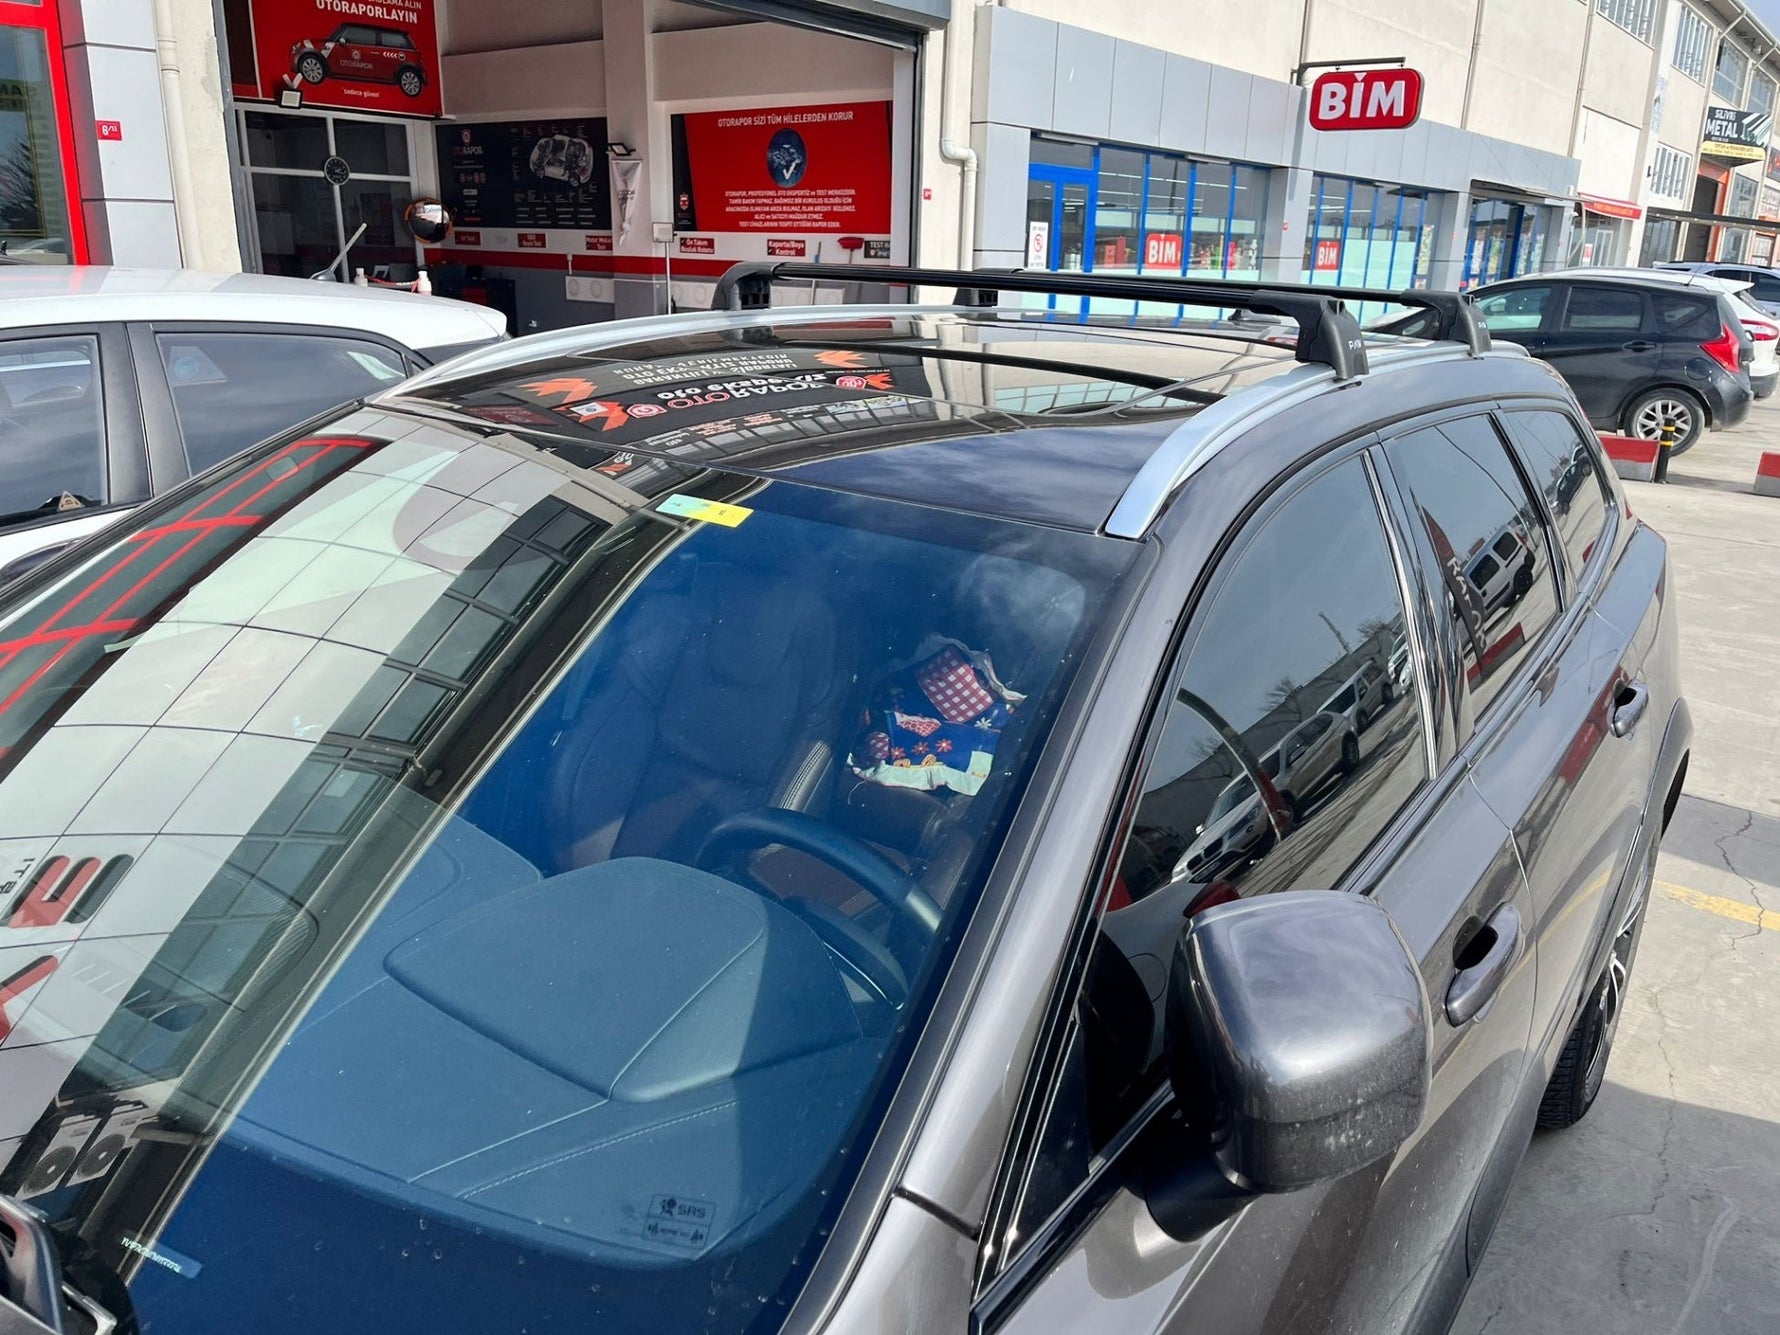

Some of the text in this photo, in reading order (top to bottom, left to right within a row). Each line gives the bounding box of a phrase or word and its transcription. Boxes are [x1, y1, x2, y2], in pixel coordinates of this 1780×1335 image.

[316, 0, 418, 24] OTORAPORLAYIN
[1318, 72, 1405, 120] BİM
[718, 110, 854, 128] OTORAPOR SİZİ TÜM HİLELERDEN KORUR
[1705, 119, 1738, 138] METAL
[870, 241, 884, 249] TEST
[1148, 234, 1176, 264] BİM
[1317, 242, 1337, 266] BİM
[677, 1204, 706, 1218] SRS
